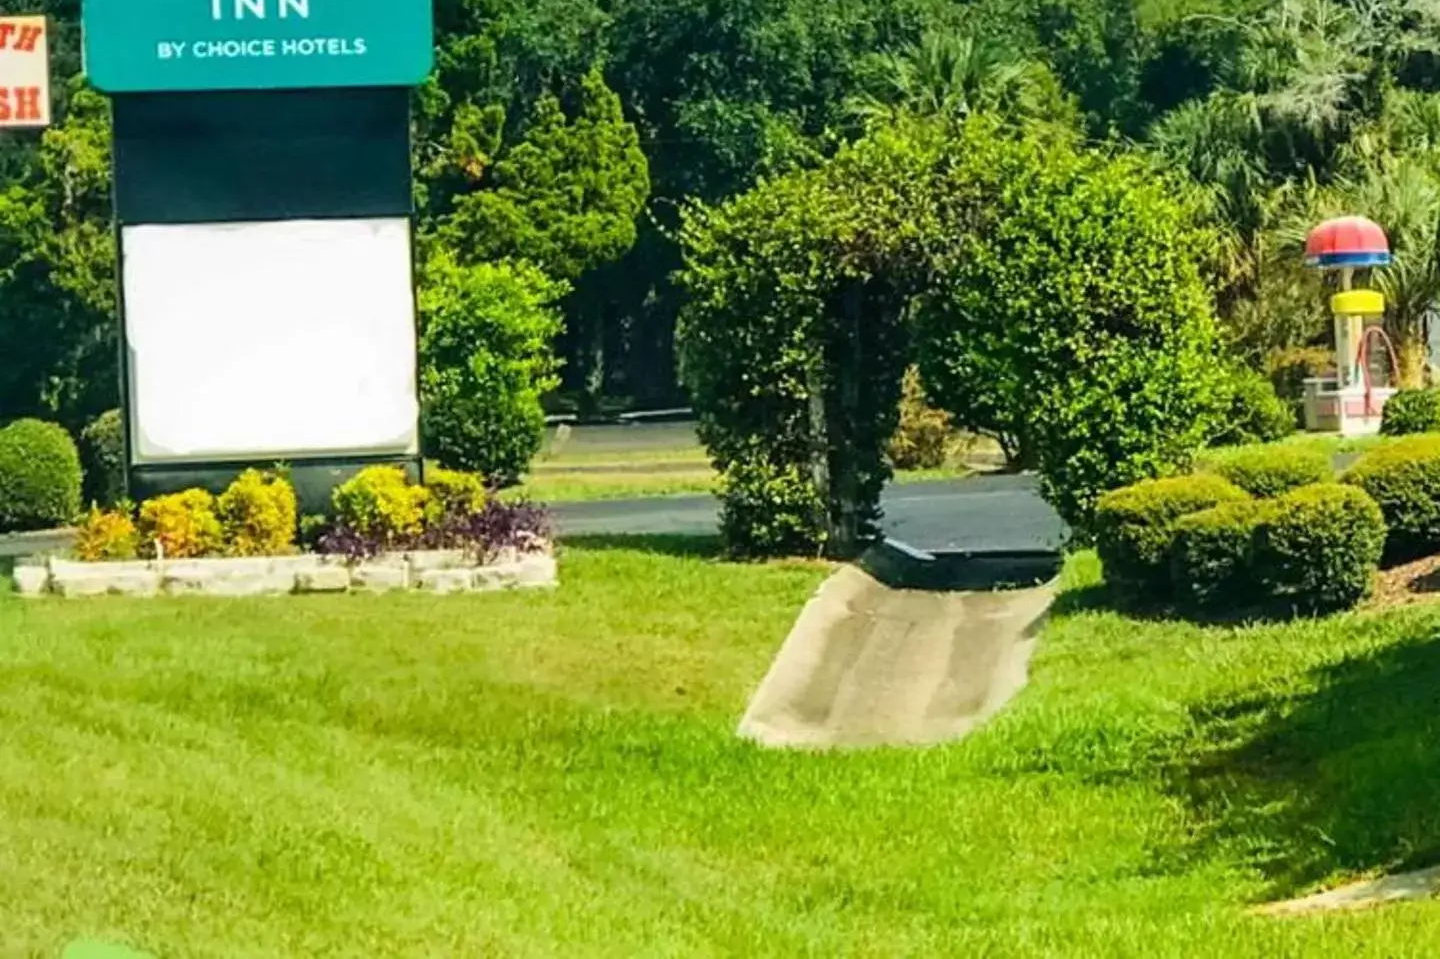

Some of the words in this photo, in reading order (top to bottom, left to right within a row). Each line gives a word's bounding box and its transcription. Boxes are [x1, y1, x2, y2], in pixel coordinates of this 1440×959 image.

[157, 42, 184, 59] BY
[193, 39, 276, 58] CHOICE
[281, 37, 367, 57] HOTELS
